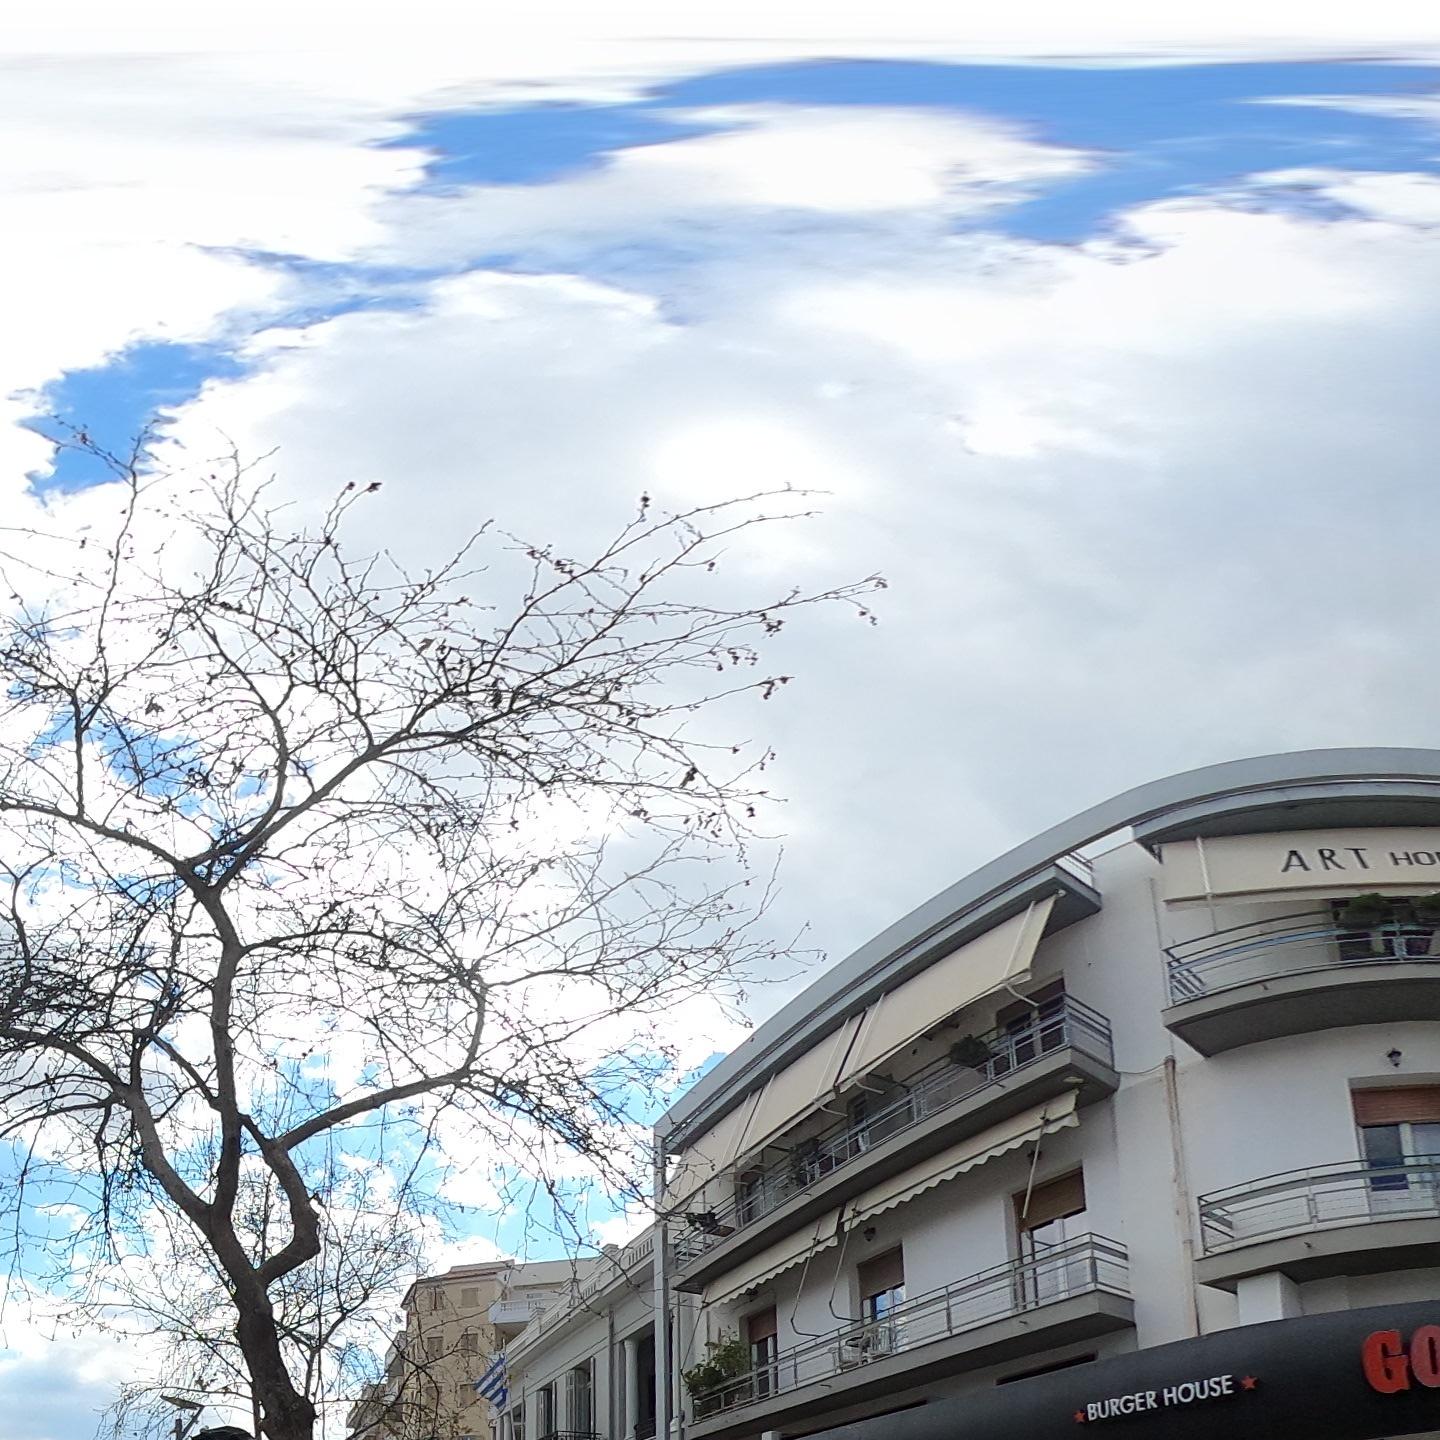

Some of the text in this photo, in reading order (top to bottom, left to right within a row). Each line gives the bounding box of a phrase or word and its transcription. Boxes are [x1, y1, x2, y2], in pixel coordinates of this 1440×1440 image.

[1281, 847, 1370, 873] ART
[1086, 1374, 1235, 1422] BURGER HOUSE
